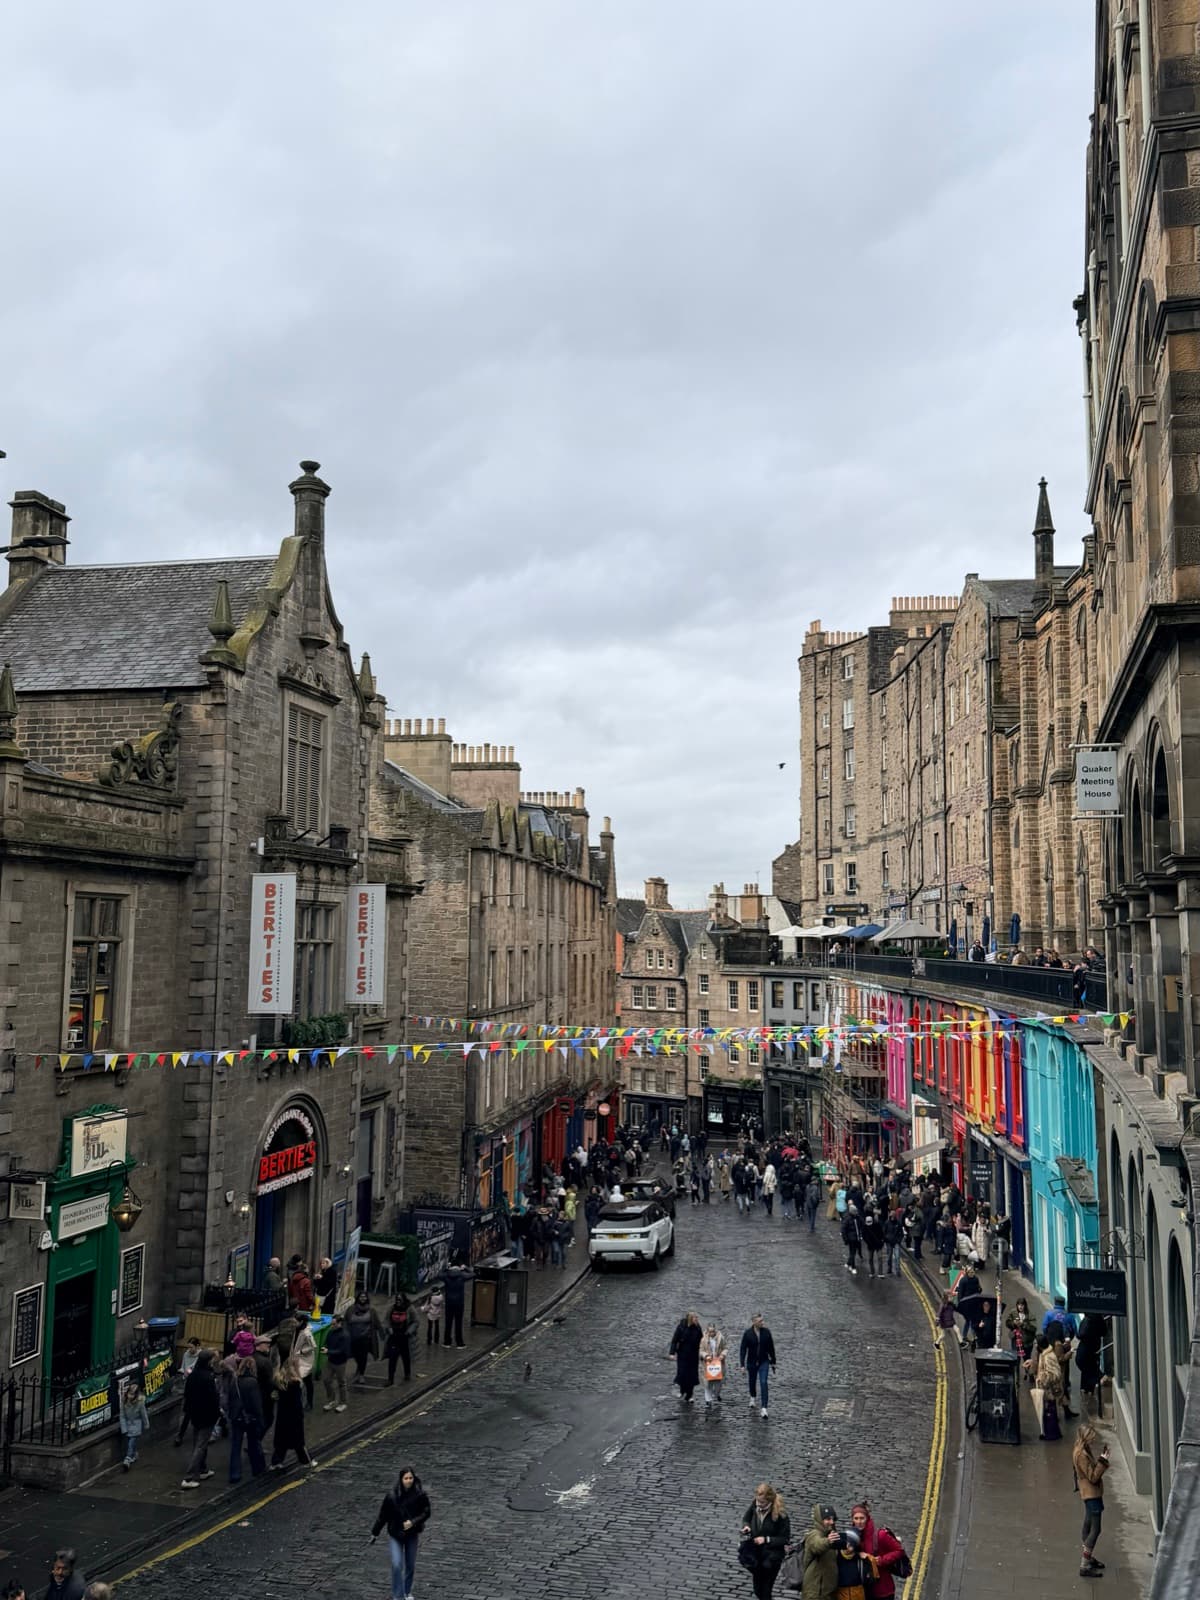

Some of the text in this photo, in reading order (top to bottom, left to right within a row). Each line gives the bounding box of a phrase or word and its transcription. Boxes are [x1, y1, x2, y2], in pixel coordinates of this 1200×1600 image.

[1081, 778, 1114, 786] Meeting
[1082, 765, 1112, 773] Quaker
[261, 883, 277, 1004] BERTIES
[356, 892, 369, 996] BERTIES
[258, 1140, 316, 1181] BERTIE'S
